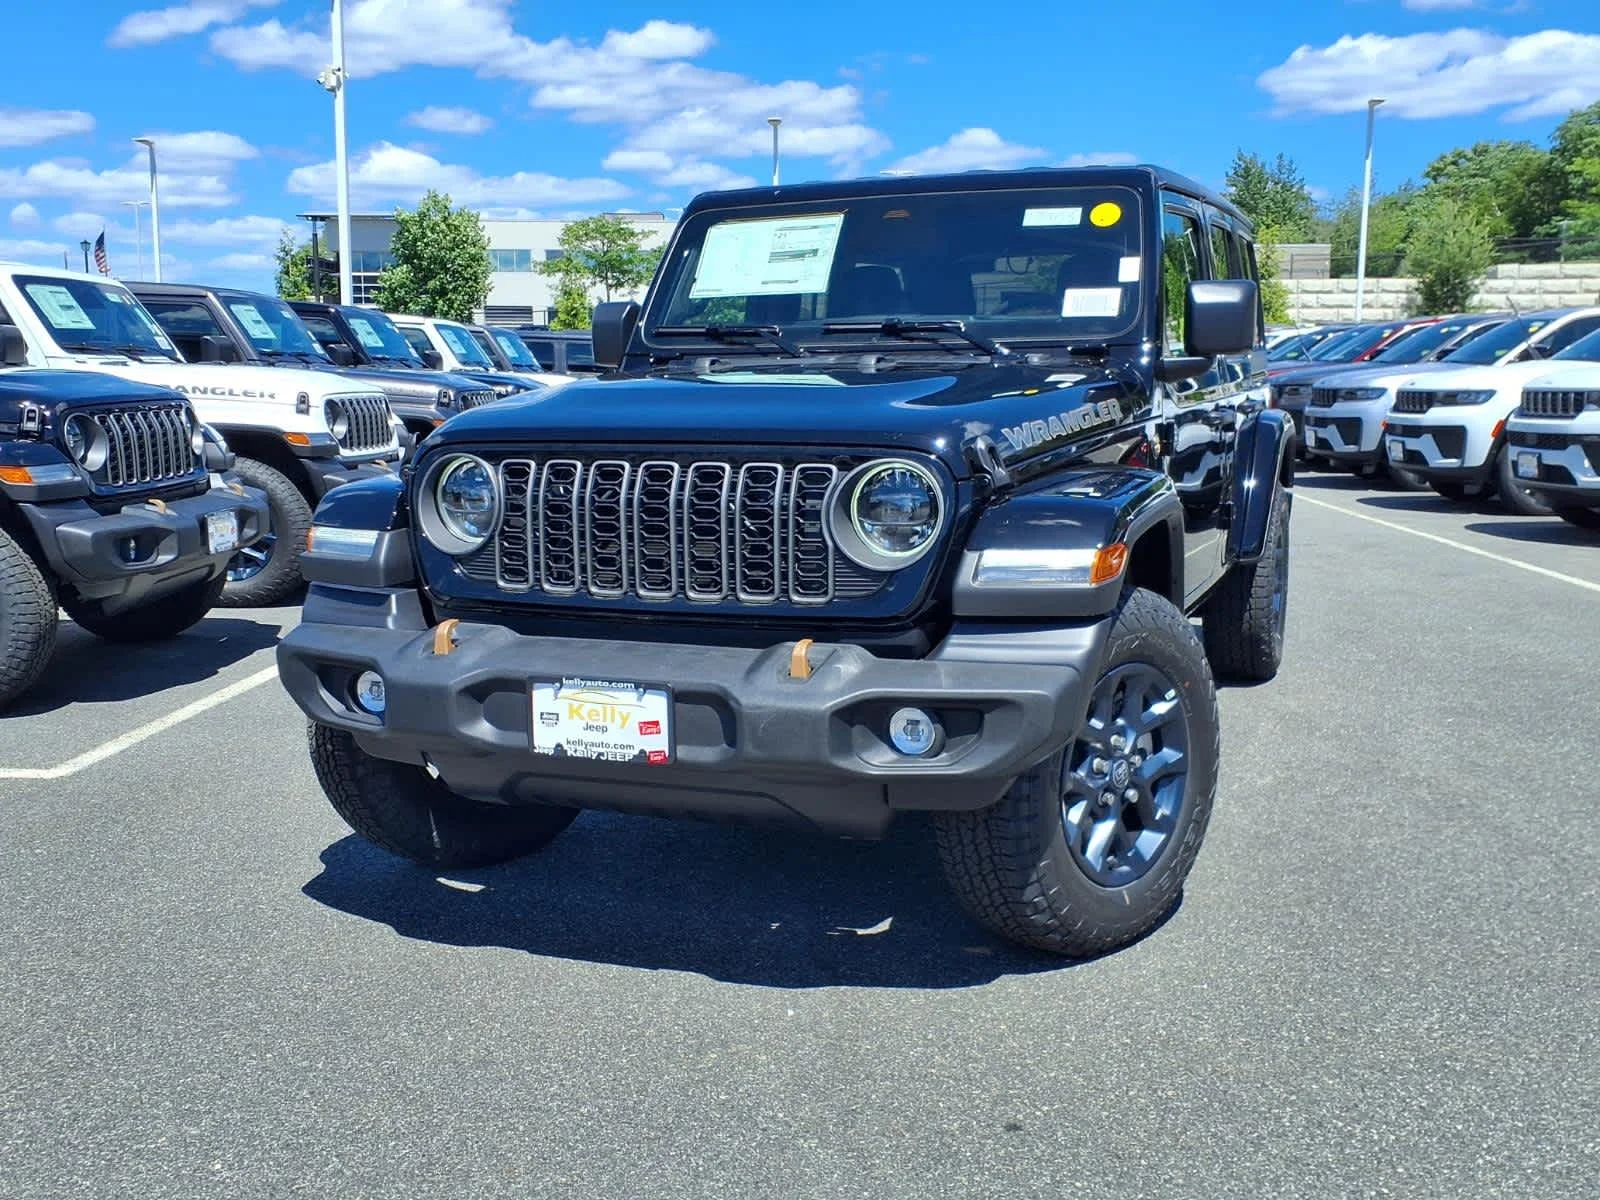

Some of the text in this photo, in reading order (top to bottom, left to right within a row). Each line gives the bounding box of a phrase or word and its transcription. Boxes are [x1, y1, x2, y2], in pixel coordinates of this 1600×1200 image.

[1001, 398, 1124, 450] WRANGLER
[562, 677, 635, 689] kellyauto.com
[567, 703, 631, 729] Kelly
[583, 722, 608, 734] Jeep
[566, 738, 635, 751] kellyauto.com
[567, 747, 634, 762] Kelly JEEP
